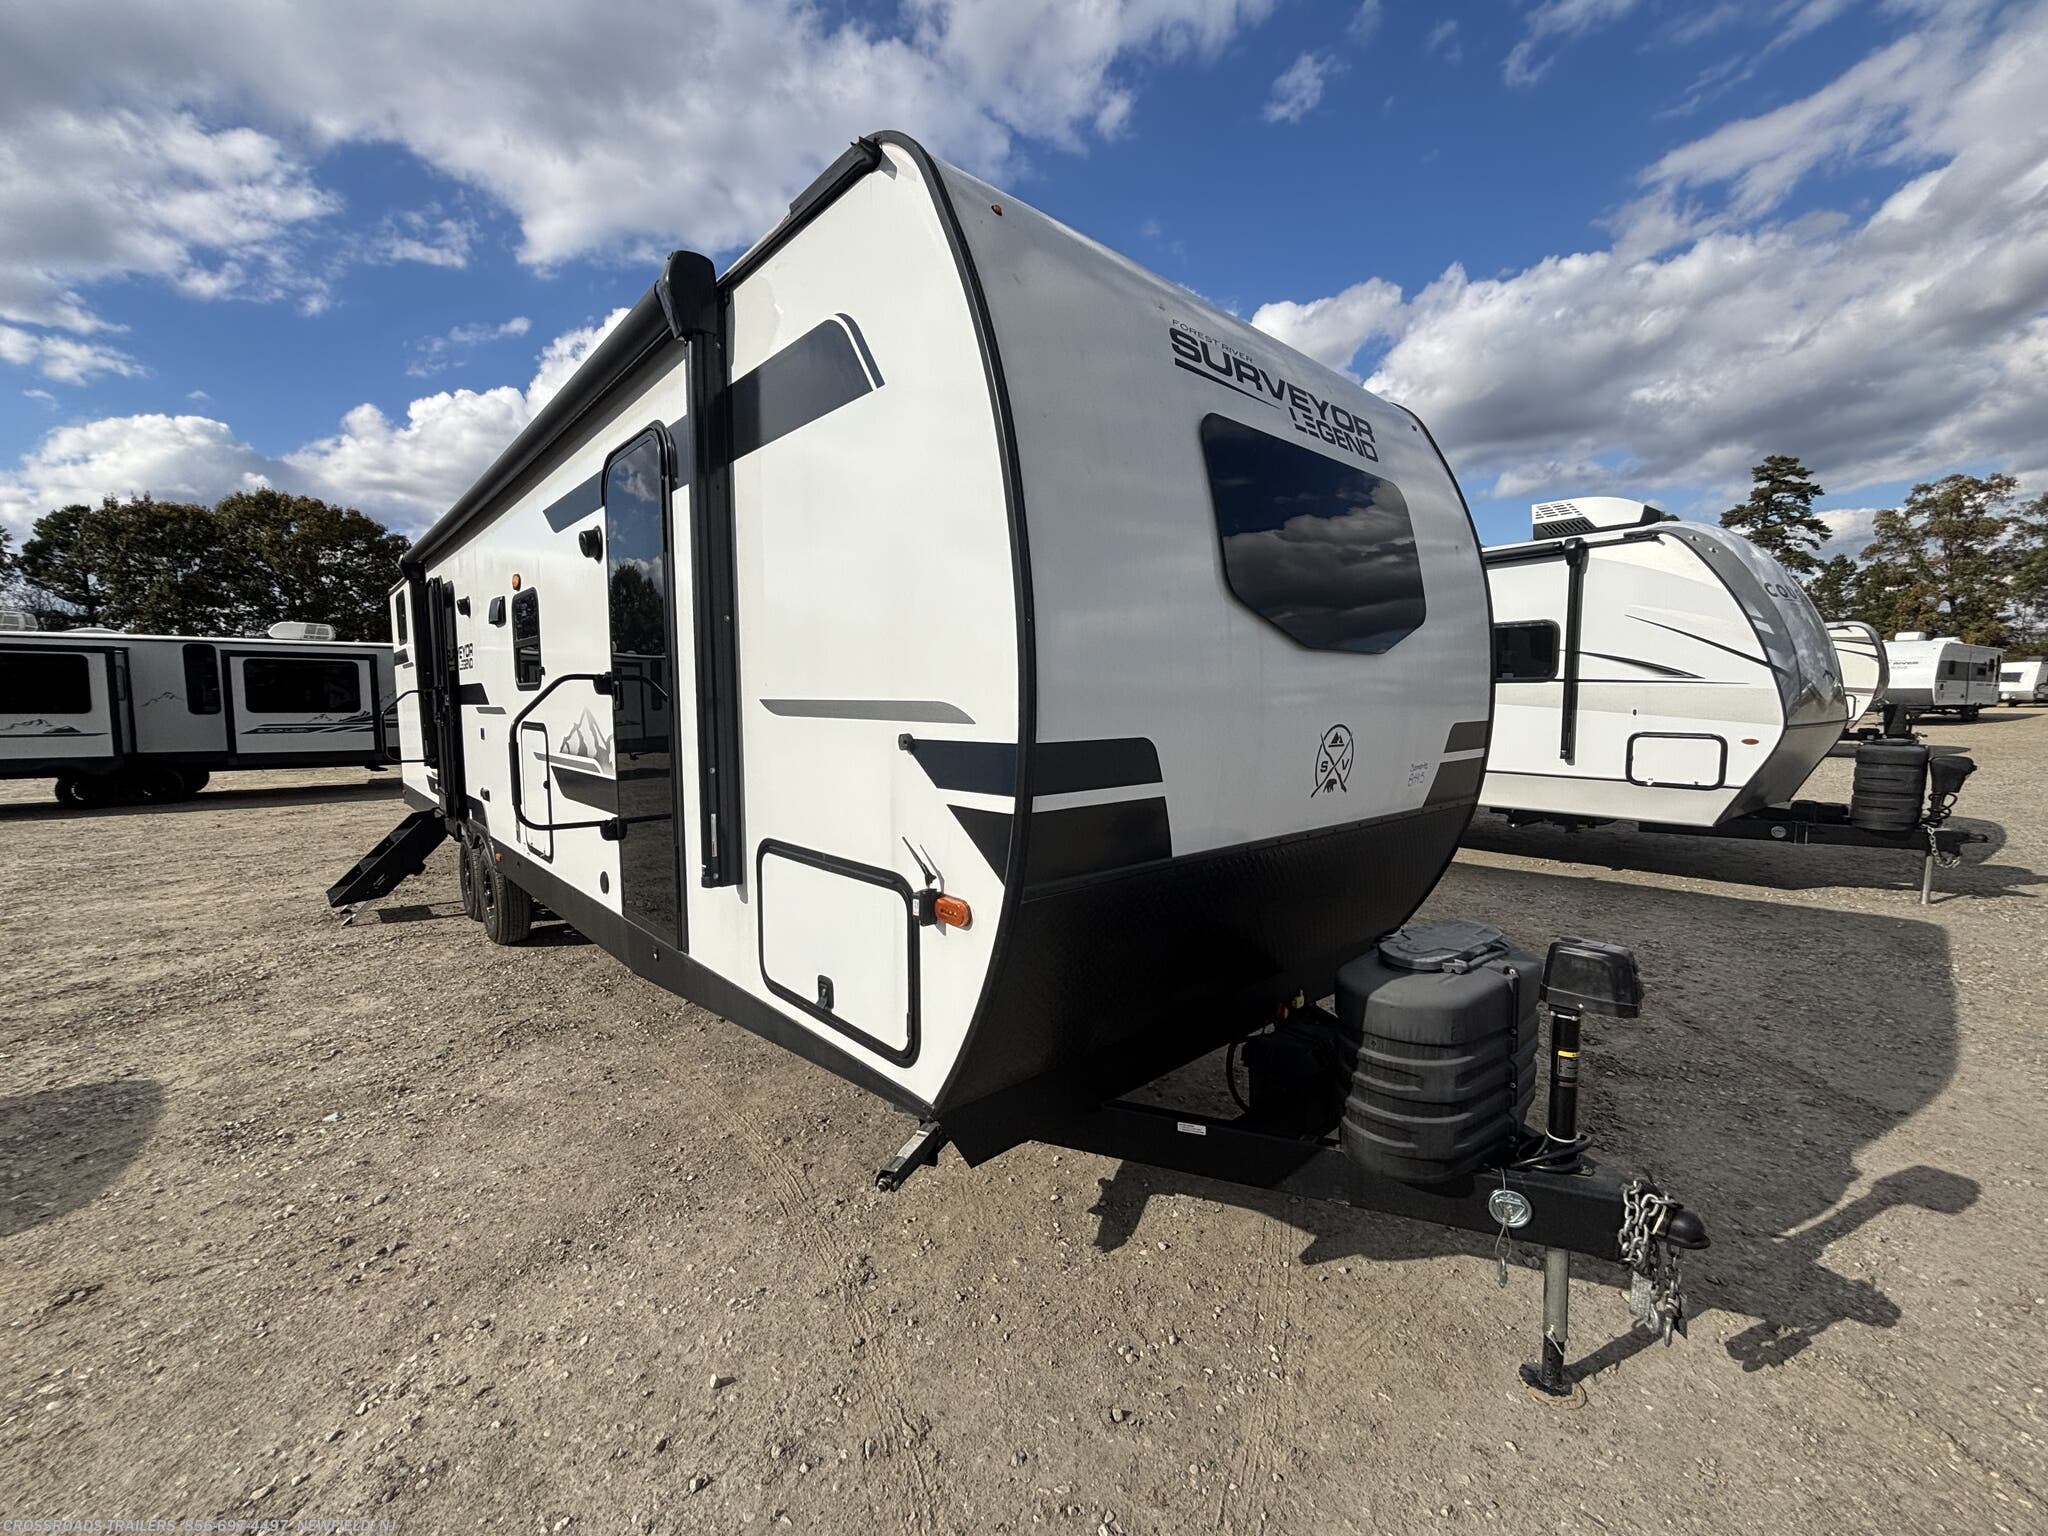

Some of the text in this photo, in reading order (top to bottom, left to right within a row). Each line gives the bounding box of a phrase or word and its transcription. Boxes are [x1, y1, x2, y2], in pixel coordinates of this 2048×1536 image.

[1171, 318, 1254, 363] FOREST RIVER
[1168, 327, 1377, 444] SURVEYOR
[1287, 406, 1379, 463] LEGEND
[1320, 758, 1350, 773] S V
